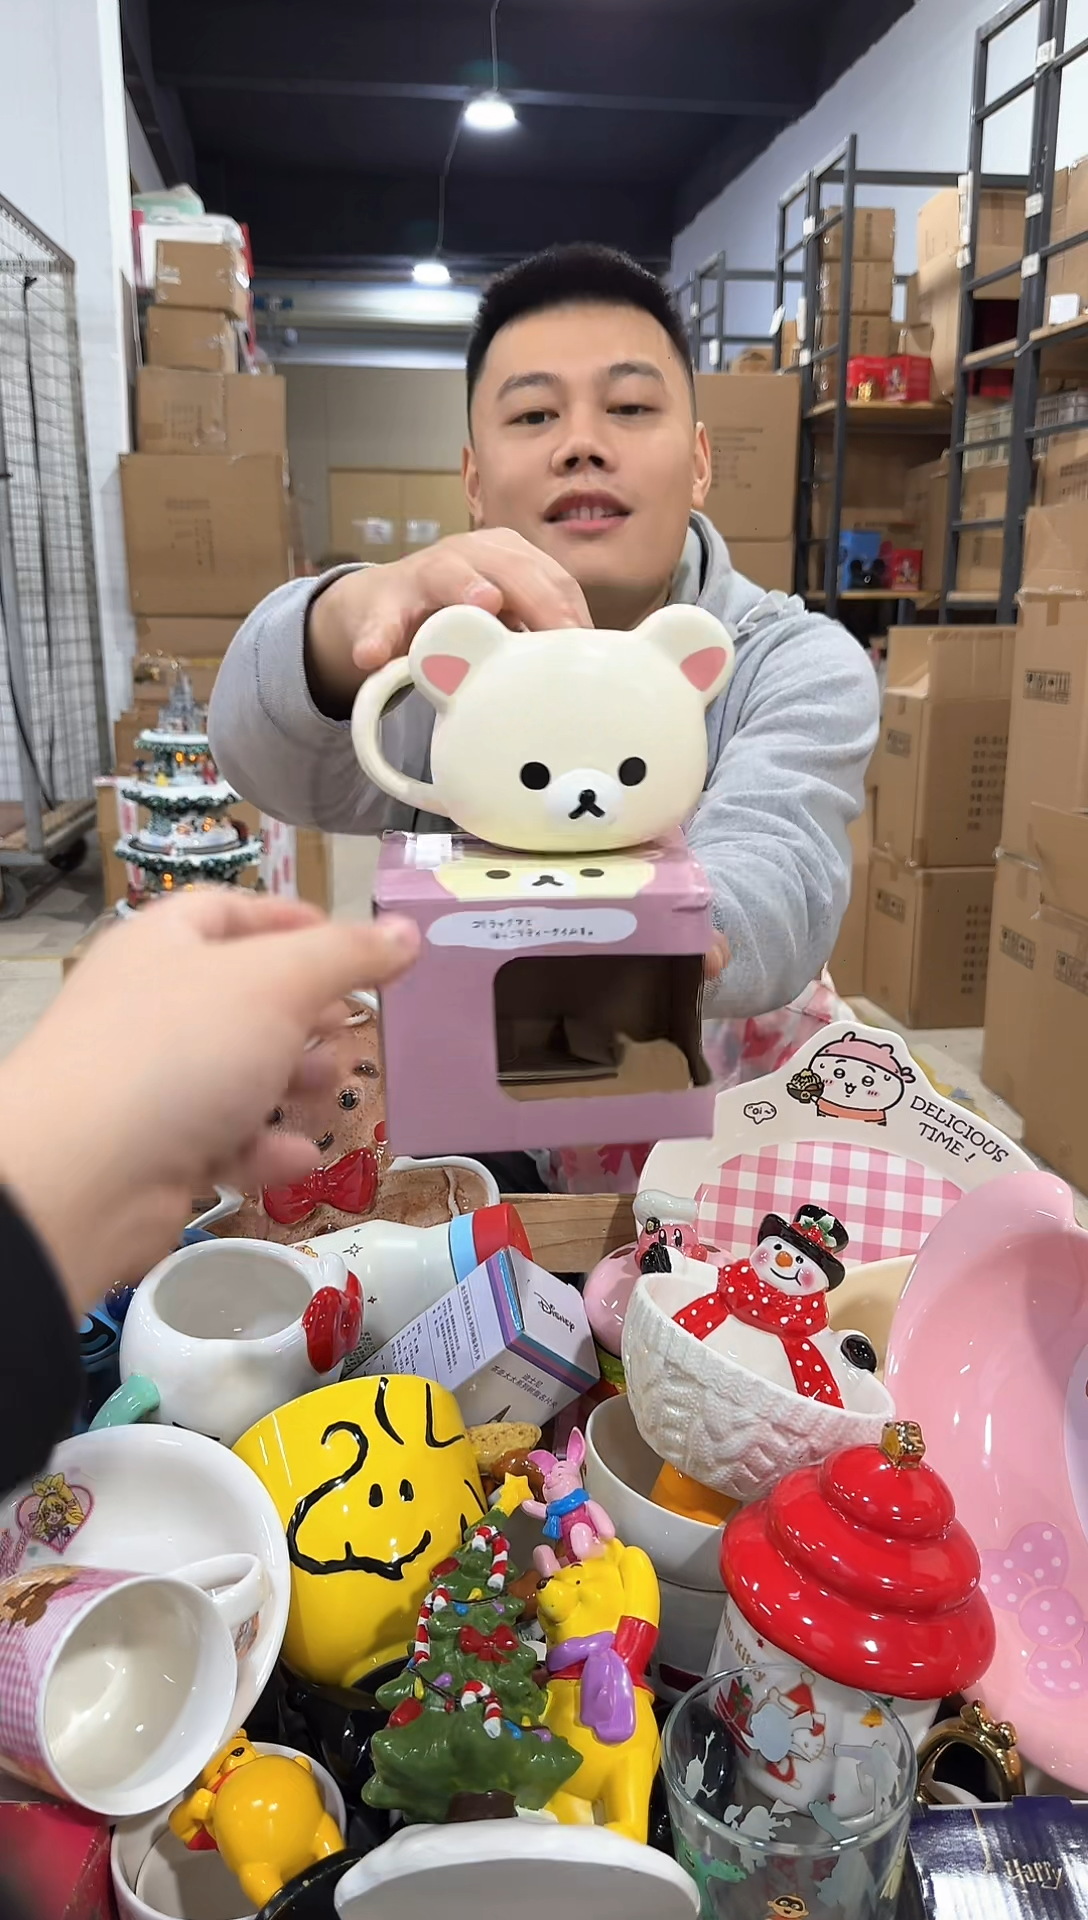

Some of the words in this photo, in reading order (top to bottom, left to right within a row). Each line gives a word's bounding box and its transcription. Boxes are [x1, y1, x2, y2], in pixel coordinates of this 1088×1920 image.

[909, 1095, 1010, 1163] DELICIOUS
[533, 1291, 577, 1334] Disney
[1004, 1858, 1063, 1891] Harry
